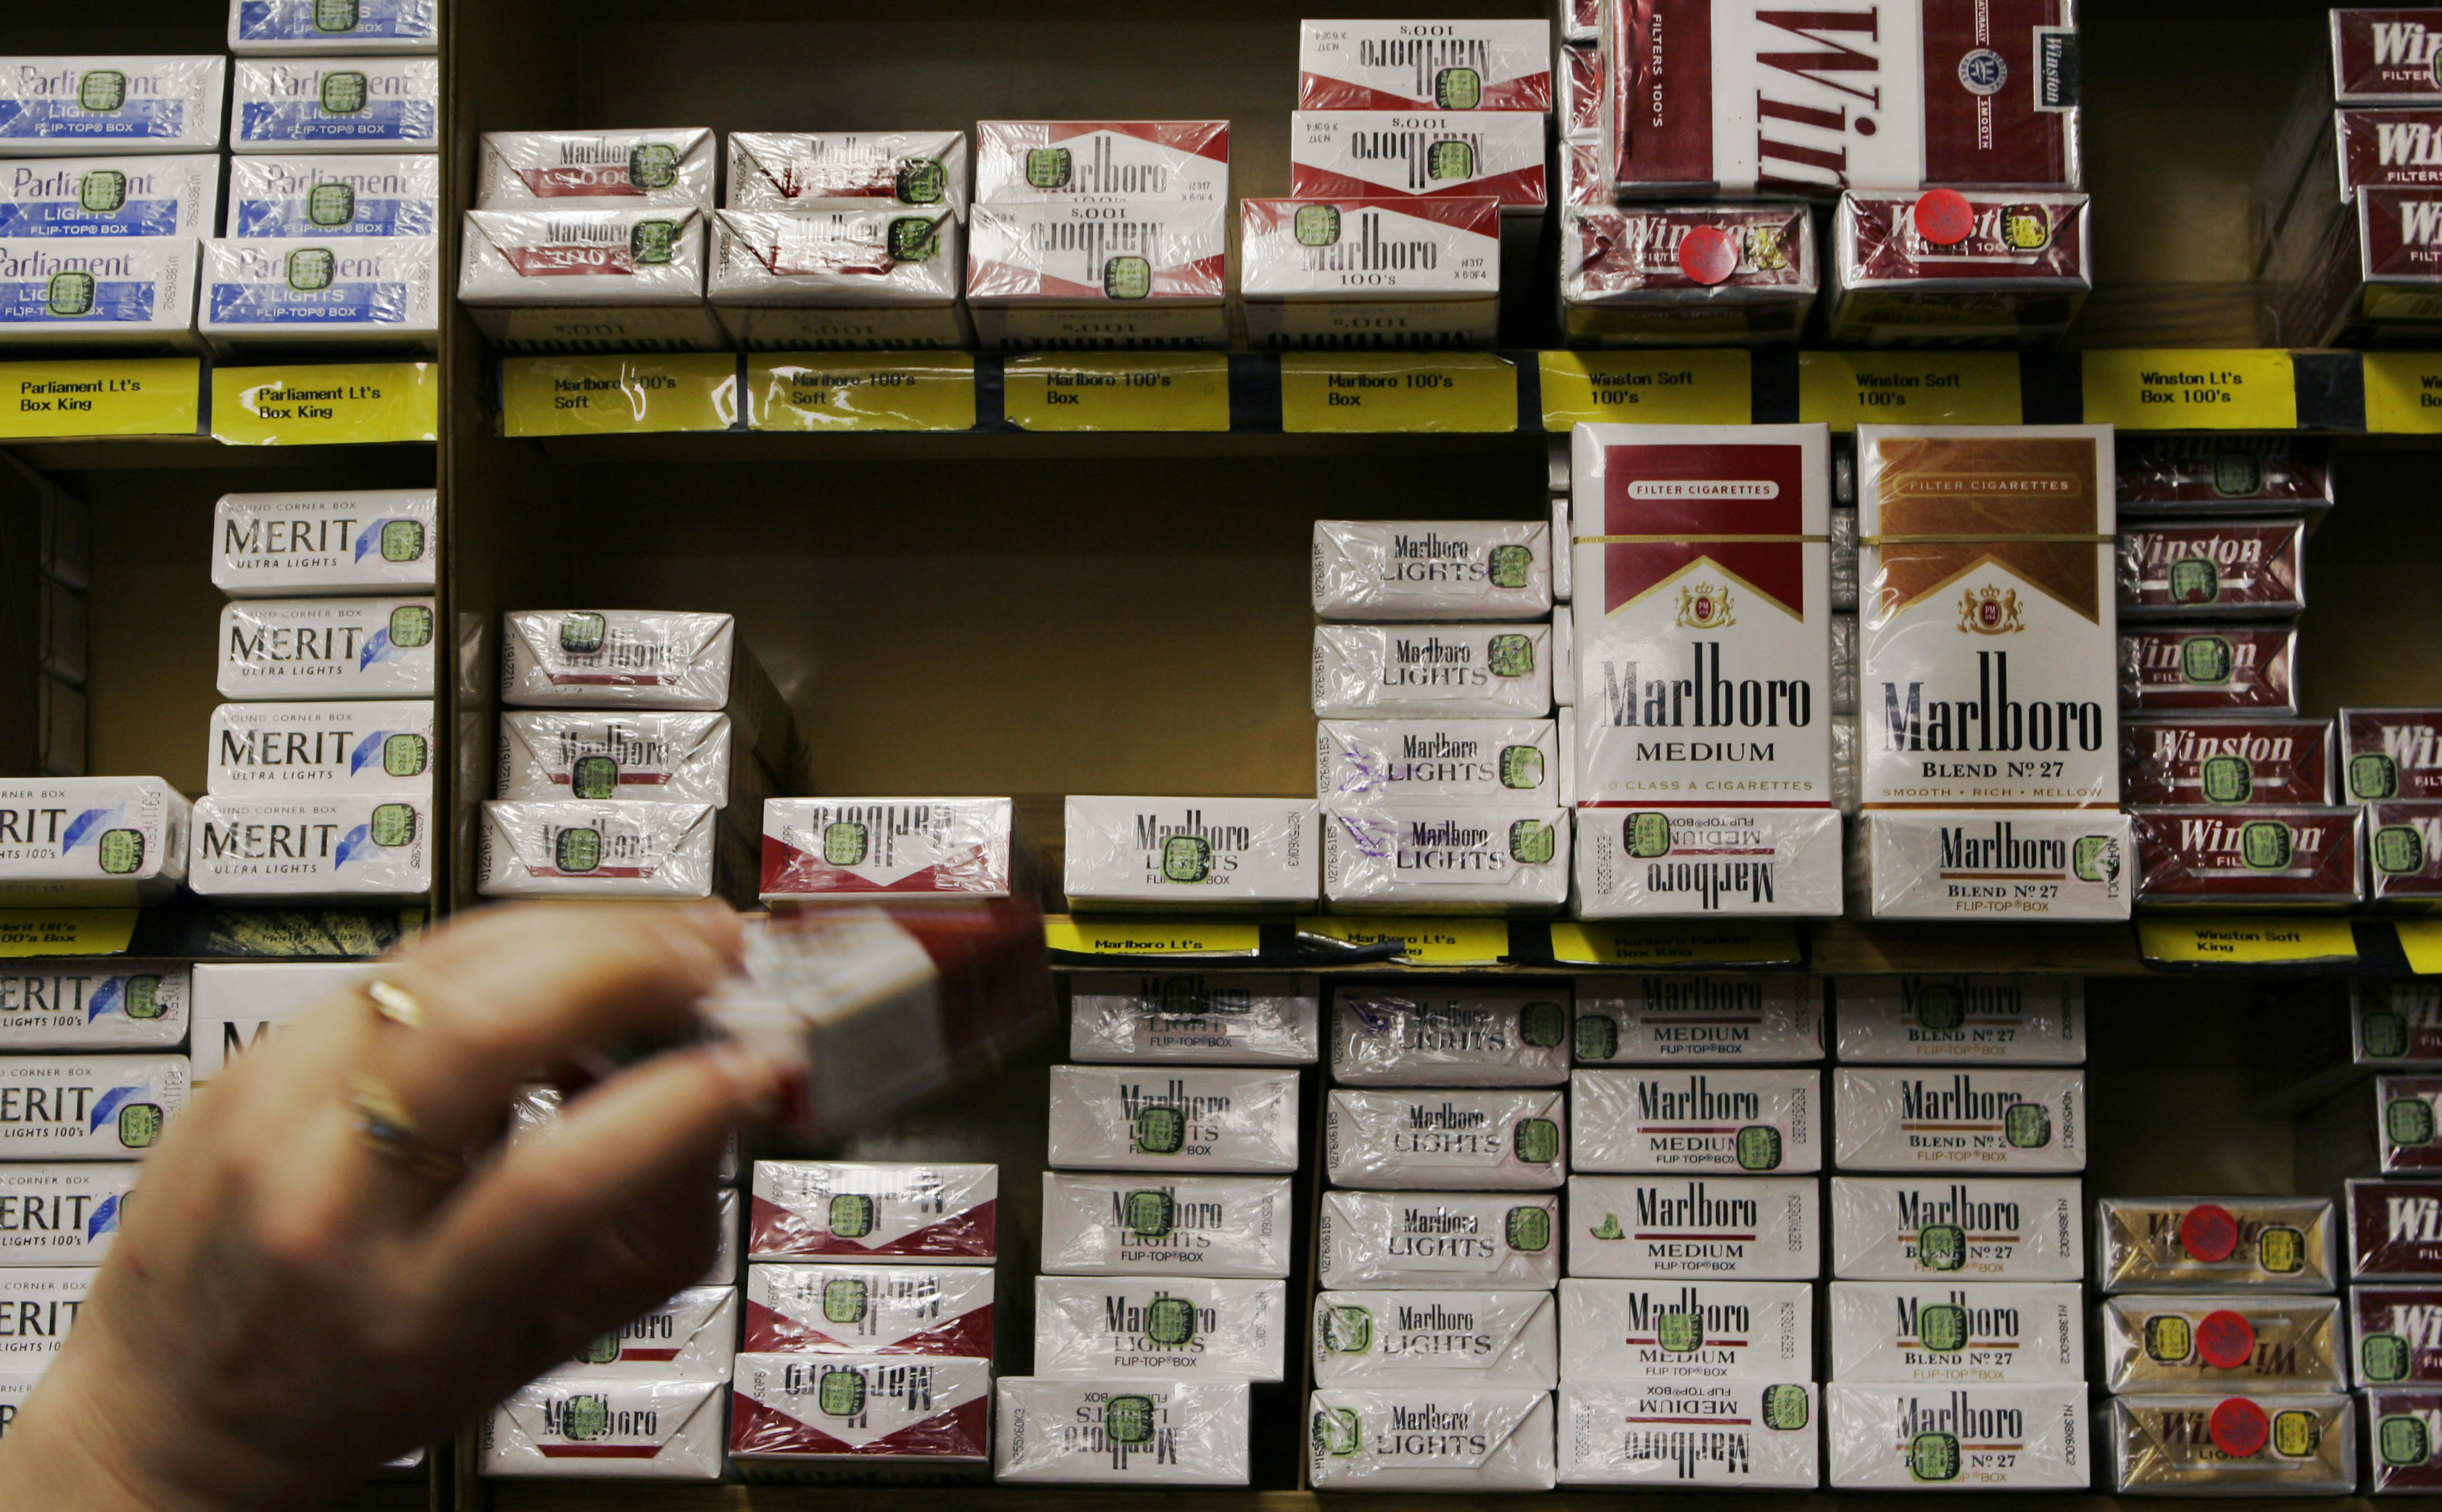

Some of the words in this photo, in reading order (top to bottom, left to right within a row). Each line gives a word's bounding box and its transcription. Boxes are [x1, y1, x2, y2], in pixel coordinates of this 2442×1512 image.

[355, 23, 382, 33] BOX
[1400, 26, 1454, 36] 100's
[1652, 14, 1663, 75] FILTERS
[1361, 39, 1492, 96] Marlboro
[2046, 38, 2061, 102] Winston
[19, 66, 161, 95] Parlient
[358, 125, 384, 133] BOX
[1393, 118, 1446, 128] 100's
[356, 224, 382, 233] BOX
[1303, 213, 1437, 272] Marlboro
[1340, 274, 1395, 286] 100's
[329, 307, 356, 317] BOX
[555, 378, 621, 391] Marlboro
[792, 374, 860, 386] Marlboro
[870, 374, 915, 386] 100's
[1047, 375, 1115, 386] Marlboro
[1124, 374, 1171, 386] 100's
[1329, 375, 1397, 388] Marlboro
[1406, 375, 1453, 388] 100's
[1589, 373, 1652, 386] Winston
[1658, 371, 1693, 385] Soft
[1856, 374, 1920, 387] Winston
[1927, 374, 1961, 387] Soft
[2141, 372, 2204, 385] Winston
[2211, 372, 2242, 384] Lt's
[20, 380, 103, 394] Parliament
[109, 378, 141, 392] Lt's
[259, 388, 342, 401] Parliament
[349, 386, 381, 399] Lt's
[793, 391, 826, 404] Soft
[1047, 392, 1079, 404] Box
[1329, 394, 1361, 406] Box
[1592, 391, 1639, 404] 100's
[1857, 392, 1906, 406] 100's
[2141, 391, 2175, 402] Box
[2184, 390, 2230, 402] 100's
[20, 399, 50, 410] Box
[57, 398, 91, 412] King
[555, 396, 588, 410] Soft
[259, 406, 290, 419] Box
[298, 405, 332, 419] King
[1689, 486, 1769, 494] CIGARETTES
[1910, 480, 1967, 490] FILTER
[1972, 480, 2069, 490] CIGARETTES
[276, 502, 325, 511] CORNER
[333, 501, 357, 510] BOX
[225, 518, 357, 555] MERIT
[1395, 535, 1469, 560] Marlboro
[237, 558, 279, 568] ULTRA
[288, 557, 337, 568] LIGHTS
[1380, 563, 1484, 581] LIGHTS
[230, 627, 362, 662] MERIT
[1396, 639, 1471, 664] Marlboro
[242, 667, 284, 676] ULTRA
[292, 665, 343, 676] LIGHTS
[1382, 667, 1487, 686] LIGHTS
[1602, 642, 1811, 728] Marlboro
[1882, 652, 2103, 752] Marlboro
[273, 713, 321, 722] CORNER
[329, 713, 352, 721] BOX
[220, 731, 353, 767] MERIT
[1403, 733, 1477, 759] Marlboro
[1637, 743, 1775, 761] MEDIUM
[2155, 731, 2293, 763] Winston
[233, 771, 275, 781] ULTRA
[283, 770, 333, 780] LIGHTS
[1388, 763, 1494, 781] LIGHTS
[1922, 763, 1997, 777] BLEND
[2041, 762, 2063, 777] 27
[1626, 781, 1679, 790] CLASS
[1706, 781, 1812, 790] CIGARETTES
[255, 805, 305, 815] CORNER
[313, 805, 337, 814] BOX
[201, 823, 338, 859] MERIT
[1412, 821, 1487, 847] Marlboro
[2180, 820, 2320, 852] Winon
[1940, 822, 2065, 869] Marlboro
[1397, 851, 1505, 870] LIGHTS
[215, 864, 257, 875] ULTRA
[266, 863, 317, 873] LIGHTS
[1207, 875, 1229, 884] BOX
[1648, 863, 1774, 909] Marlboro
[1948, 885, 2006, 897] BLEND
[2040, 885, 2058, 897] 27
[2196, 931, 2260, 942] Winston
[2265, 931, 2301, 942] Soft
[1095, 940, 1164, 949] Marlboro
[1171, 940, 1203, 949] Lt's
[2197, 942, 2234, 952] King
[1616, 949, 1650, 958] Box
[1656, 949, 1693, 958] King
[4, 1018, 46, 1026] LIGHTS
[1653, 1028, 1749, 1042] MEDIUM
[1909, 1029, 1964, 1042] BLEND
[1997, 1029, 2015, 1042] 27
[1, 1087, 93, 1122] ERIT
[1638, 1076, 1759, 1121] Marlboro
[1409, 1102, 1484, 1130] Marlboro
[4, 1129, 49, 1137] LIGHTS
[1395, 1134, 1501, 1153] LIGHTS
[1909, 1136, 1965, 1148] BLEND
[1635, 1182, 1757, 1227] Marlboro
[1403, 1208, 1478, 1233] Marlboro
[1389, 1238, 1495, 1258] LIGHTS
[1648, 1244, 1743, 1258] MEDIUM
[1995, 1246, 2013, 1258] 27
[1398, 1305, 1473, 1331] Marlboro
[1384, 1335, 1492, 1355] LIGHTS
[1640, 1350, 1735, 1364] MEDIUM
[1905, 1353, 1961, 1365] BLEND
[1995, 1353, 2013, 1365] 27
[1640, 1400, 1738, 1414] MEDIUM
[1392, 1405, 1468, 1431] Marlboro
[1377, 1436, 1486, 1455] LIGHTS
[1624, 1432, 1751, 1479] Marlboro
